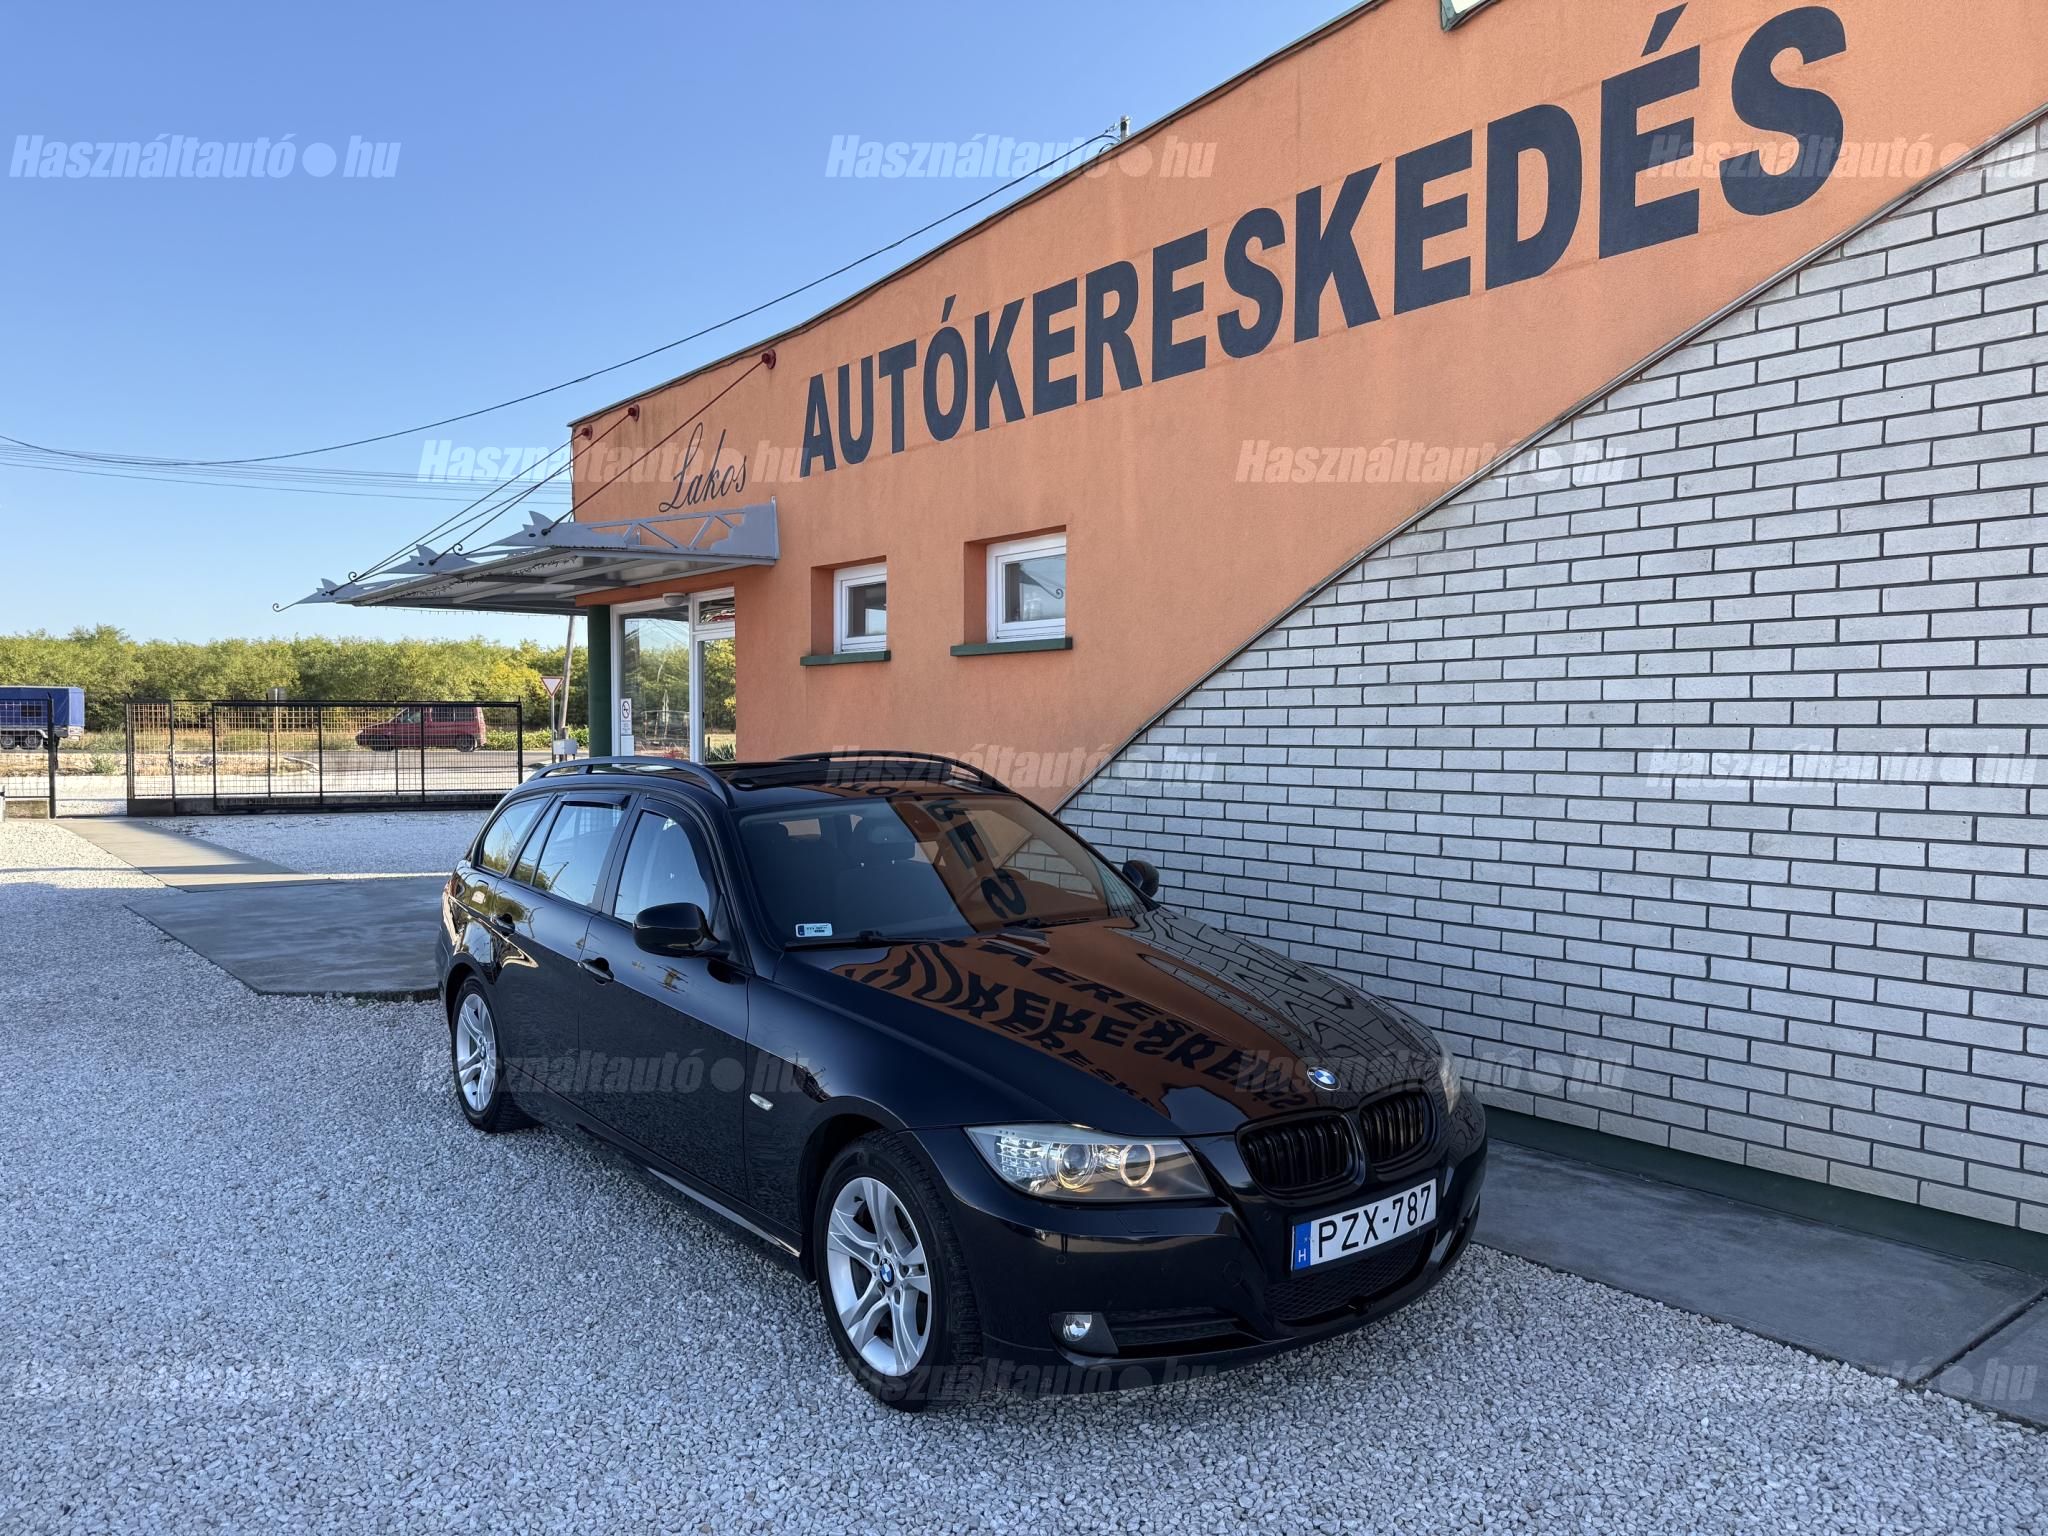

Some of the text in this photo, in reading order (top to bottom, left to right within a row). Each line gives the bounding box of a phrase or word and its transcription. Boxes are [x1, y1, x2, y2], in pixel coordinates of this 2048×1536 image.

[799, 3, 1845, 477] AUTÓKERESKEDÉS
[658, 422, 748, 513] Lakos
[1298, 1184, 1432, 1263] H PZX-787
